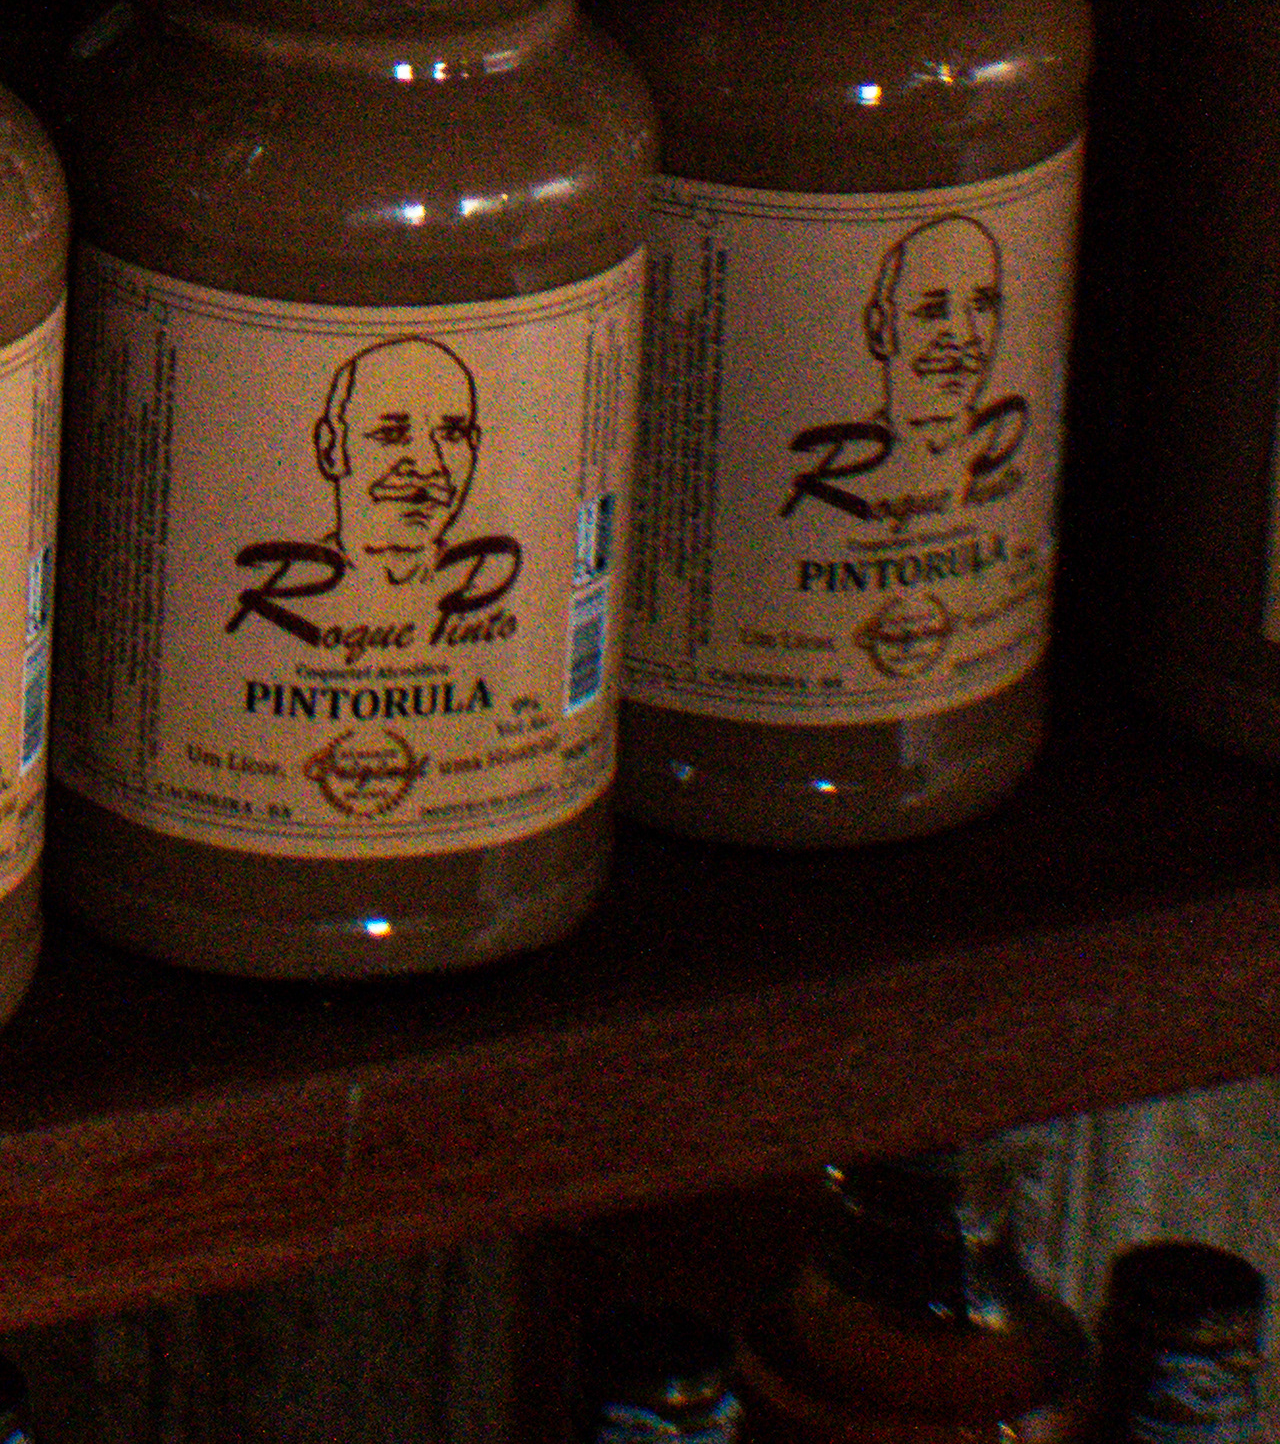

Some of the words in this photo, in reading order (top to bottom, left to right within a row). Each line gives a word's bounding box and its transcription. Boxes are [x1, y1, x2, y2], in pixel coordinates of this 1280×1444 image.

[226, 541, 414, 665] Roque
[429, 534, 523, 647] Pinto
[245, 677, 493, 722] PINTORULA
